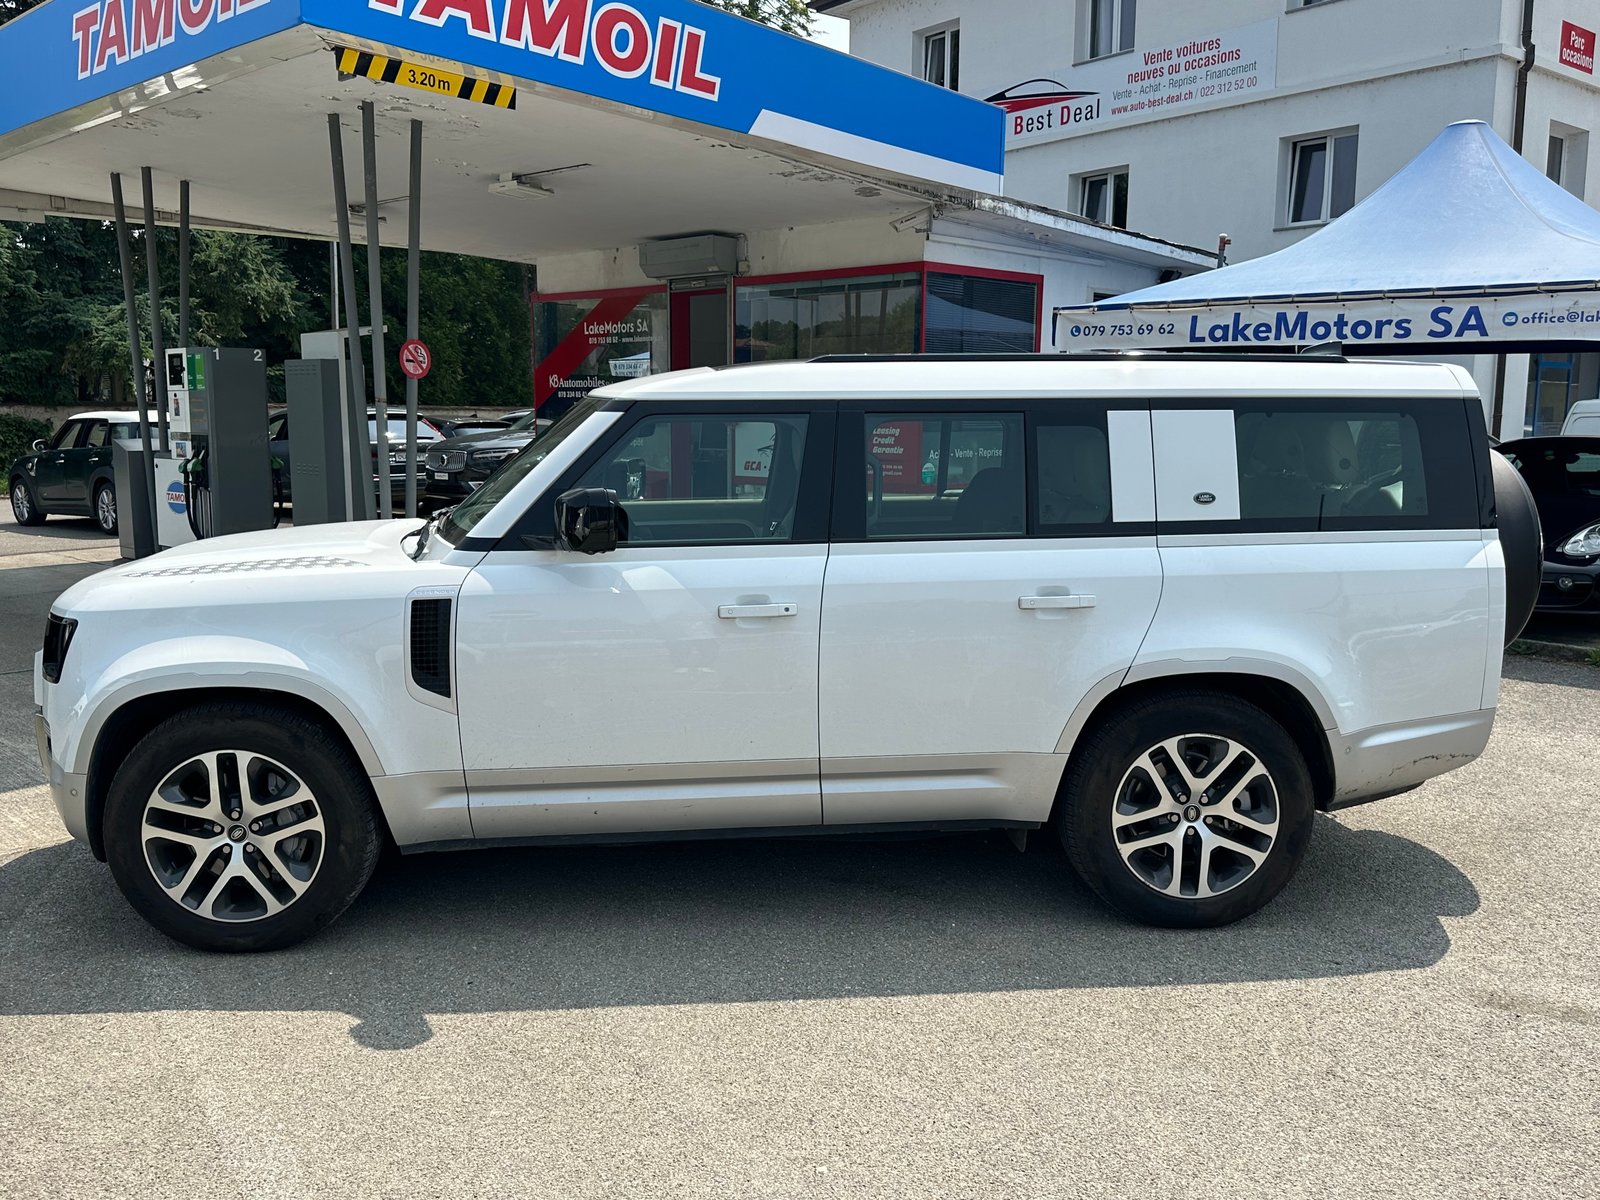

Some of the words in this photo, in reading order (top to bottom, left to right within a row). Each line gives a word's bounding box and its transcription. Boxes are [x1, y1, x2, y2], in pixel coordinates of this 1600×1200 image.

[72, 0, 270, 80] TAM
[1570, 31, 1585, 50] Parc
[368, 0, 721, 101] MOIL
[1143, 51, 1173, 66] Vente
[1176, 38, 1221, 58] voitures
[1562, 47, 1593, 69] occasions
[1127, 66, 1164, 84] neuves
[1168, 64, 1181, 75] ou
[1184, 48, 1241, 72] occasions
[1112, 88, 1132, 101] Vente
[1139, 82, 1161, 96] Achat
[1168, 74, 1197, 90] Reprise
[1205, 61, 1257, 81] Financement
[1111, 90, 1193, 115] www.auto-best-deal.ch
[1200, 86, 1215, 98] 022
[1217, 82, 1231, 94] 312
[1234, 78, 1245, 91] 52
[1246, 76, 1257, 87] 00
[1014, 109, 1053, 135] Best
[1060, 98, 1100, 126] Deal
[584, 320, 634, 335] LakeMotors
[636, 319, 649, 333] SA
[1083, 325, 1105, 337] 079
[1110, 324, 1133, 336] 753
[1137, 323, 1153, 335] 69
[1158, 323, 1175, 335] 62
[1189, 311, 1412, 343] LakeMotors
[1427, 305, 1489, 338] SA
[213, 348, 220, 360] 1
[253, 350, 263, 361] 2
[872, 426, 900, 436] Leasing
[872, 446, 904, 454] Garantie
[954, 448, 974, 458] Vente
[978, 447, 1003, 459] Reprise
[744, 460, 761, 471] GCA
[166, 492, 185, 502] TAMO
